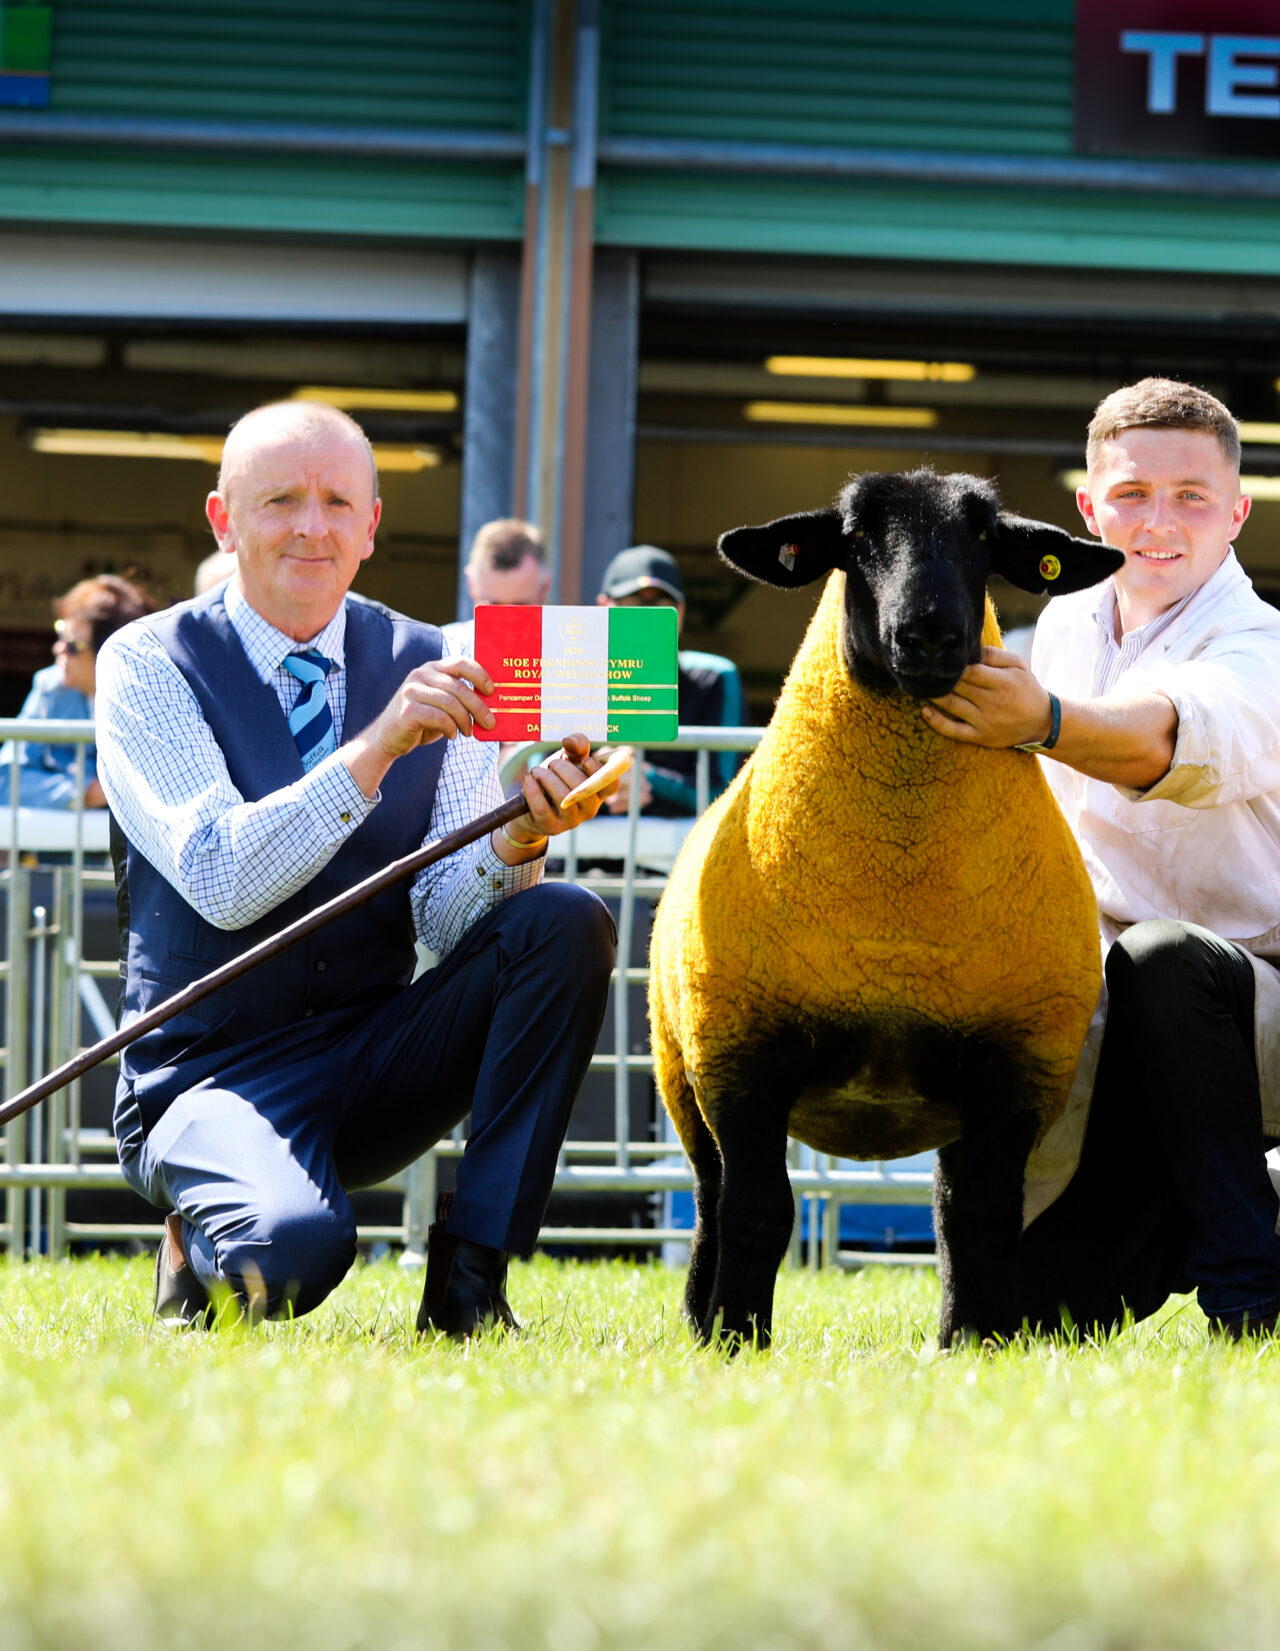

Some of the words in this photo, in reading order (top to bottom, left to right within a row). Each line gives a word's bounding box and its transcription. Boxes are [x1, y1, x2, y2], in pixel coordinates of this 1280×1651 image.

[502, 658, 530, 668] SIOE
[600, 659, 644, 669] CYMRU
[514, 669, 553, 679] ROYAL
[599, 670, 633, 680] SHOW
[499, 694, 533, 702] Pencampwr
[611, 694, 631, 702] Suffolk
[632, 694, 652, 703] Sheep
[526, 723, 540, 733] DA
[303, 745, 325, 767] Suffolk
